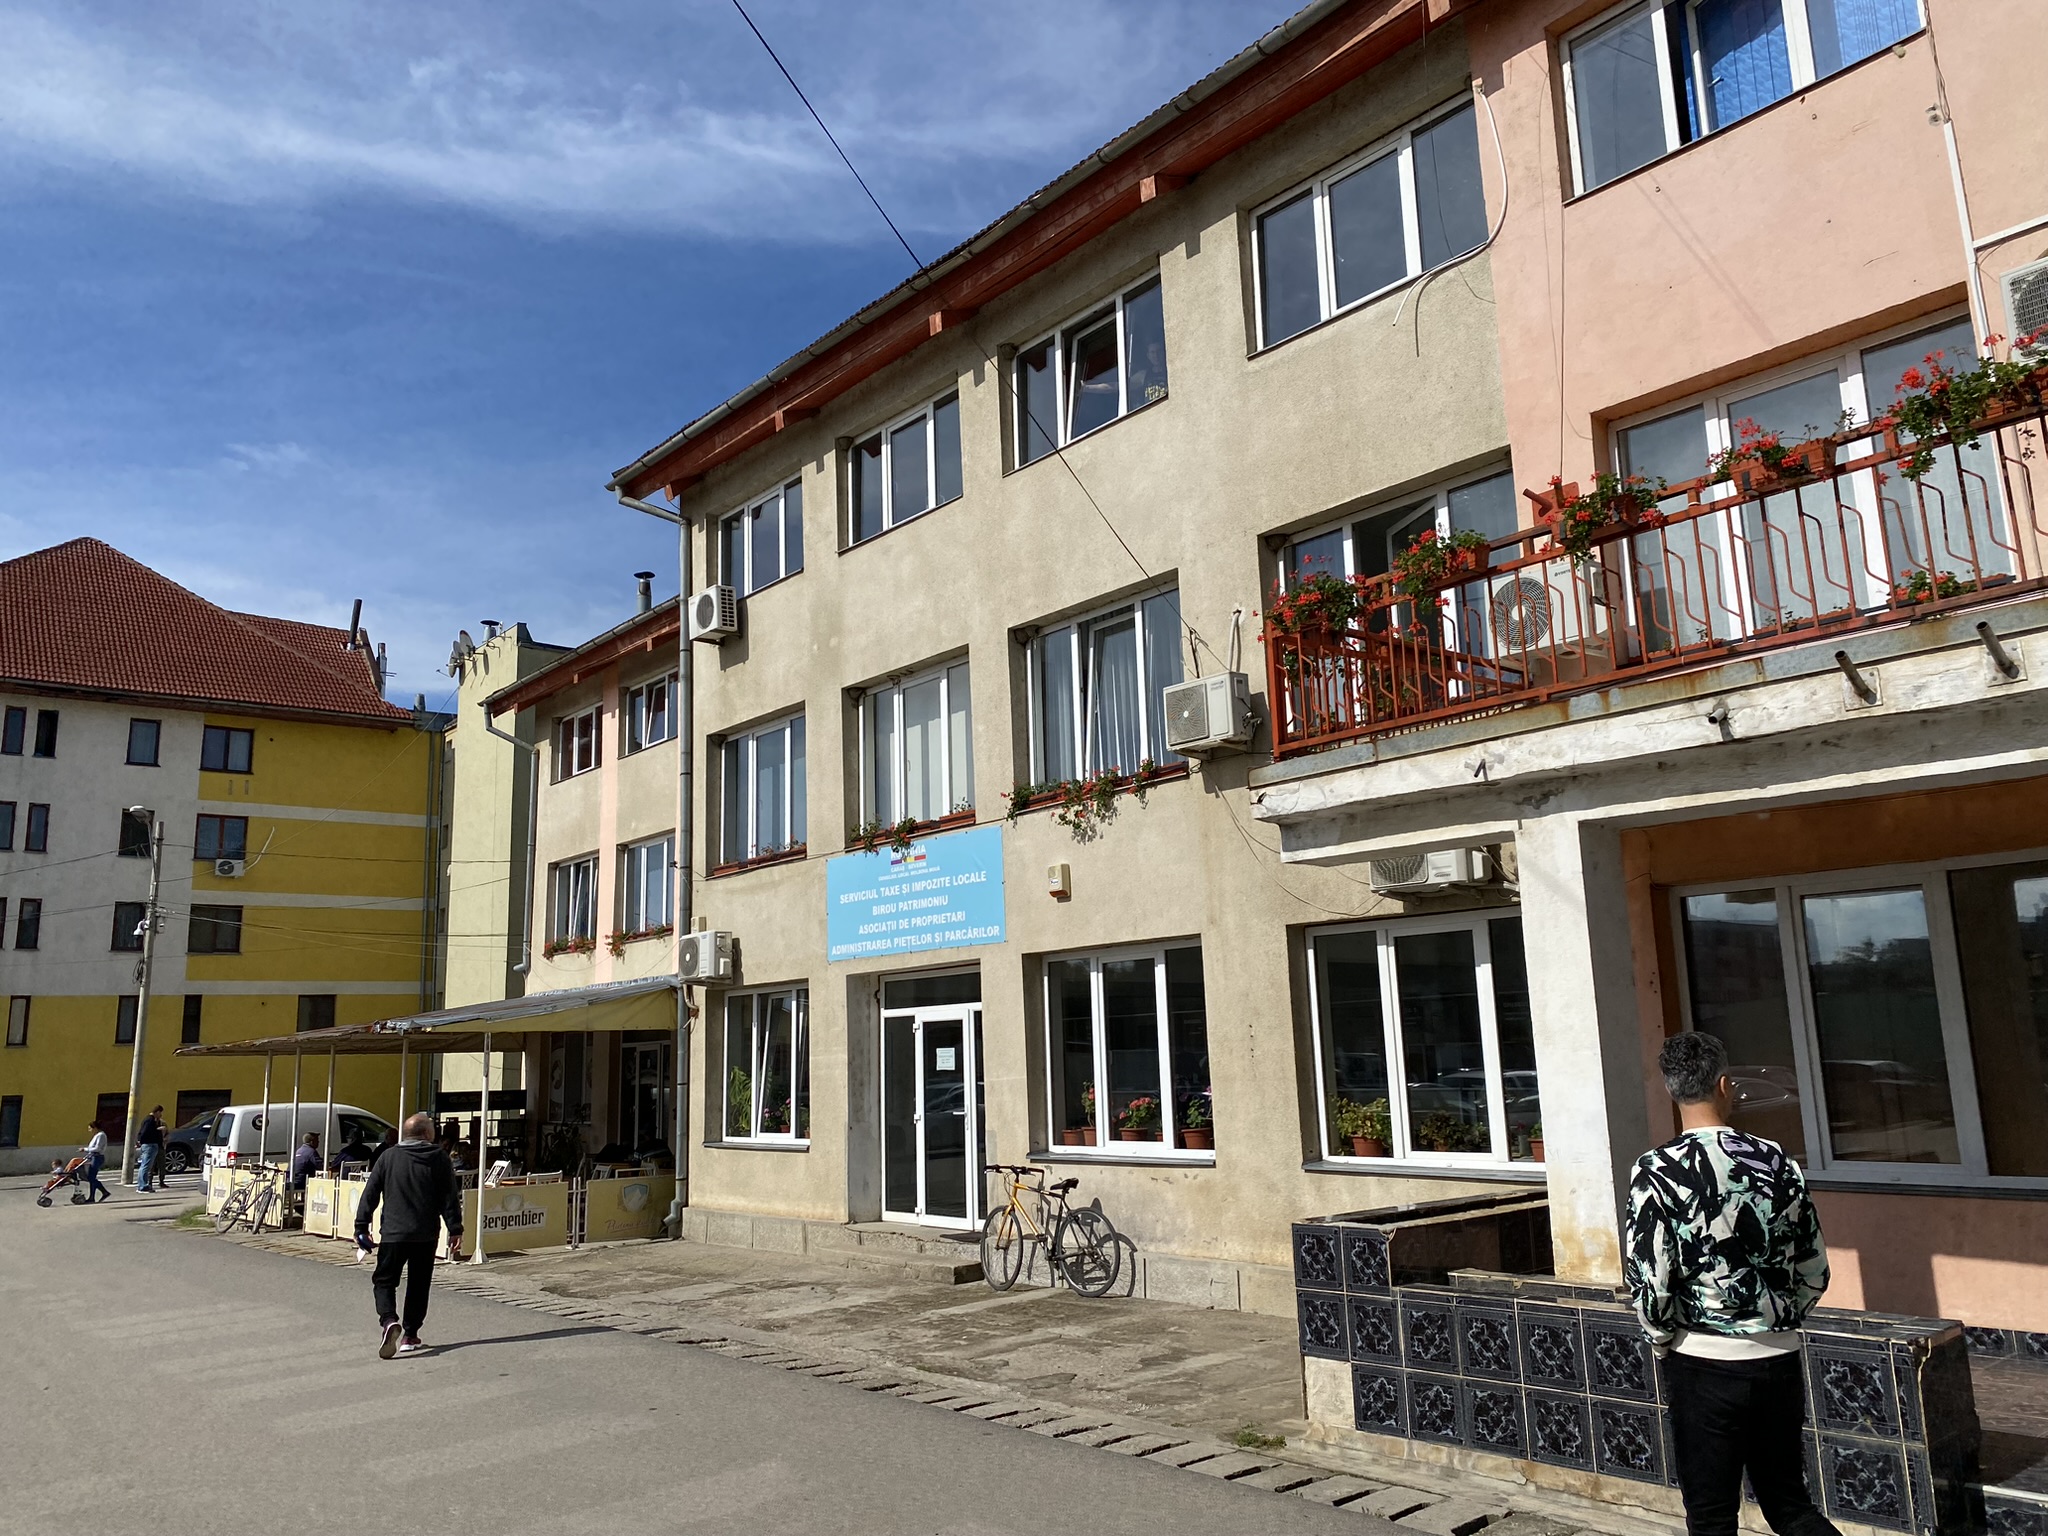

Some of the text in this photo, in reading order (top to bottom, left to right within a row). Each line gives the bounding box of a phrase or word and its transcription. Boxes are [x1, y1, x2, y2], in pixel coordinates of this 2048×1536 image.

[840, 889, 878, 904] SERVICIUL
[880, 885, 900, 897] TAXE
[912, 876, 951, 892] IMPOZITE
[953, 871, 987, 886] LOCALE
[872, 895, 949, 916] BIROU PATRIMONIU
[899, 918, 910, 929] DE
[911, 911, 966, 927] PROPRIETARI
[831, 938, 892, 955] ADMINISTRAREA
